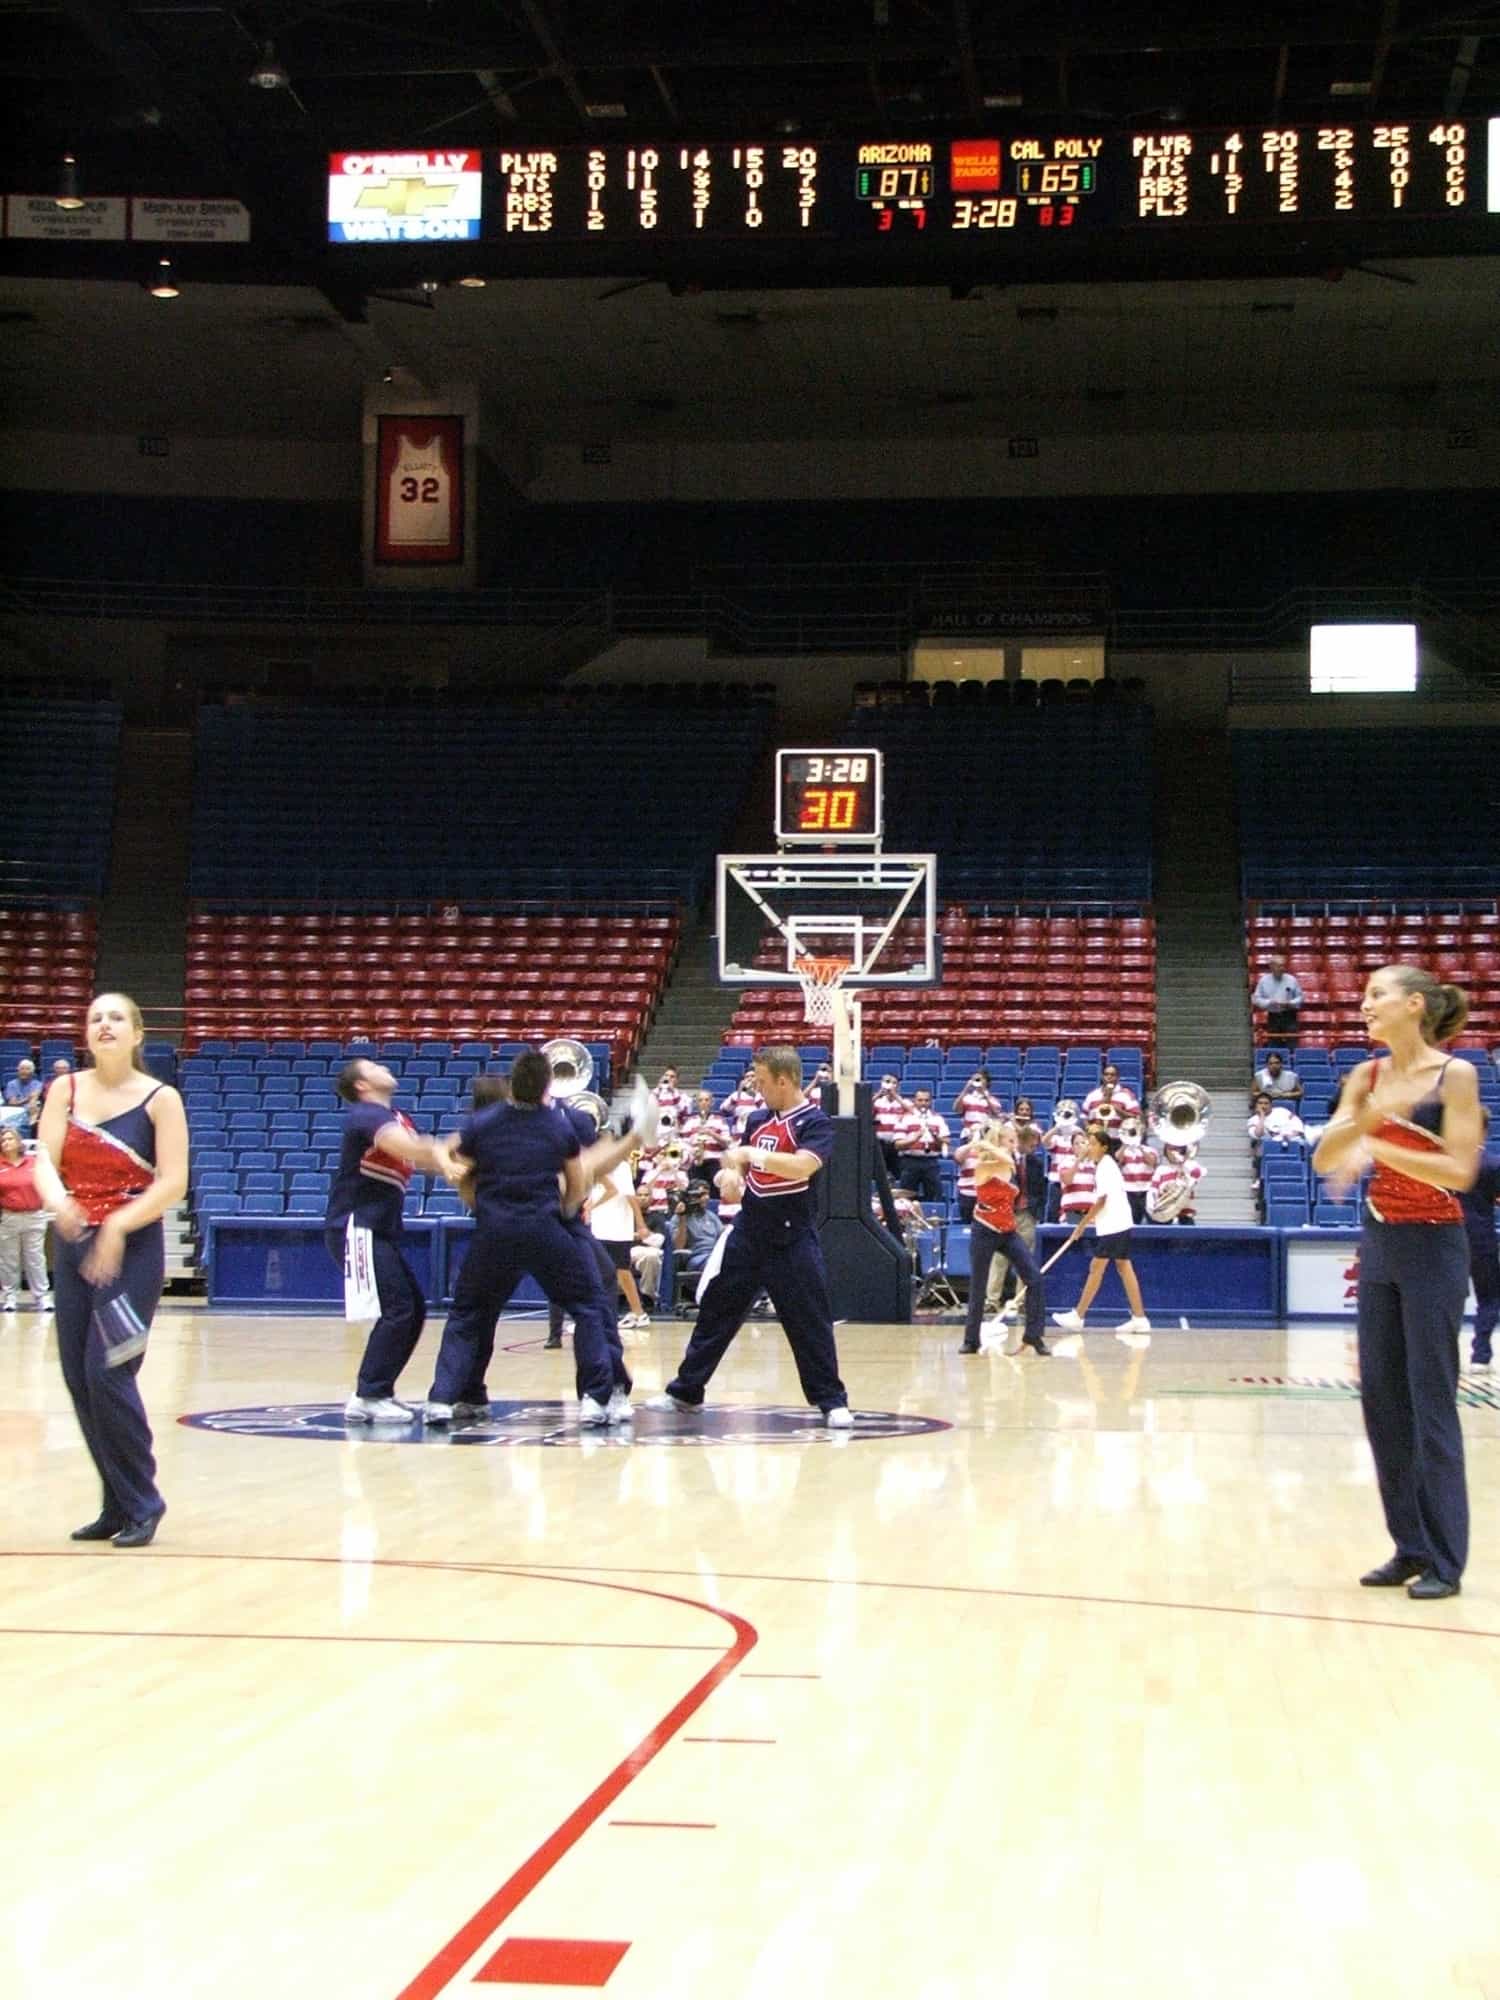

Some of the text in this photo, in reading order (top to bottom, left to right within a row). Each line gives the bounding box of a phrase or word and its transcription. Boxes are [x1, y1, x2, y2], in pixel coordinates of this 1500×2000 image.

[1010, 138, 1102, 160] CAL POLY
[1133, 124, 1465, 157] PLYR 4 20 22 25 40
[501, 148, 817, 174] PLYR 2 10 14 15 20
[859, 144, 932, 164] ARIZONA
[953, 156, 999, 167] WELLS
[1143, 157, 1185, 176] PTS
[1211, 154, 1237, 174] 11
[1265, 151, 1298, 172] 12
[1390, 147, 1409, 168] 0
[1446, 145, 1465, 165] 0
[510, 173, 550, 192] PTS
[588, 170, 605, 190] 0
[627, 171, 651, 190] 11
[746, 169, 763, 188] 0
[799, 167, 816, 188] 7
[880, 169, 918, 197] 87
[954, 167, 999, 177] FARGO
[1041, 164, 1080, 192] 65
[1139, 176, 1187, 197] RBS
[1225, 174, 1243, 194] 3
[1280, 171, 1298, 192] 5
[1335, 169, 1353, 190] 4
[1390, 167, 1409, 188] 0
[506, 188, 816, 212] RBS 1 5 3 1 3
[1139, 186, 1465, 217] FLS 1 2 2 1 0
[506, 208, 809, 232] FLS 2 0 1 0 1
[878, 209, 893, 231] 3
[912, 209, 926, 231] 7
[952, 199, 1017, 229] 3:28
[1059, 204, 1075, 226] 3
[400, 477, 440, 503] 32
[806, 758, 868, 783] 3:28
[801, 791, 857, 829] 30
